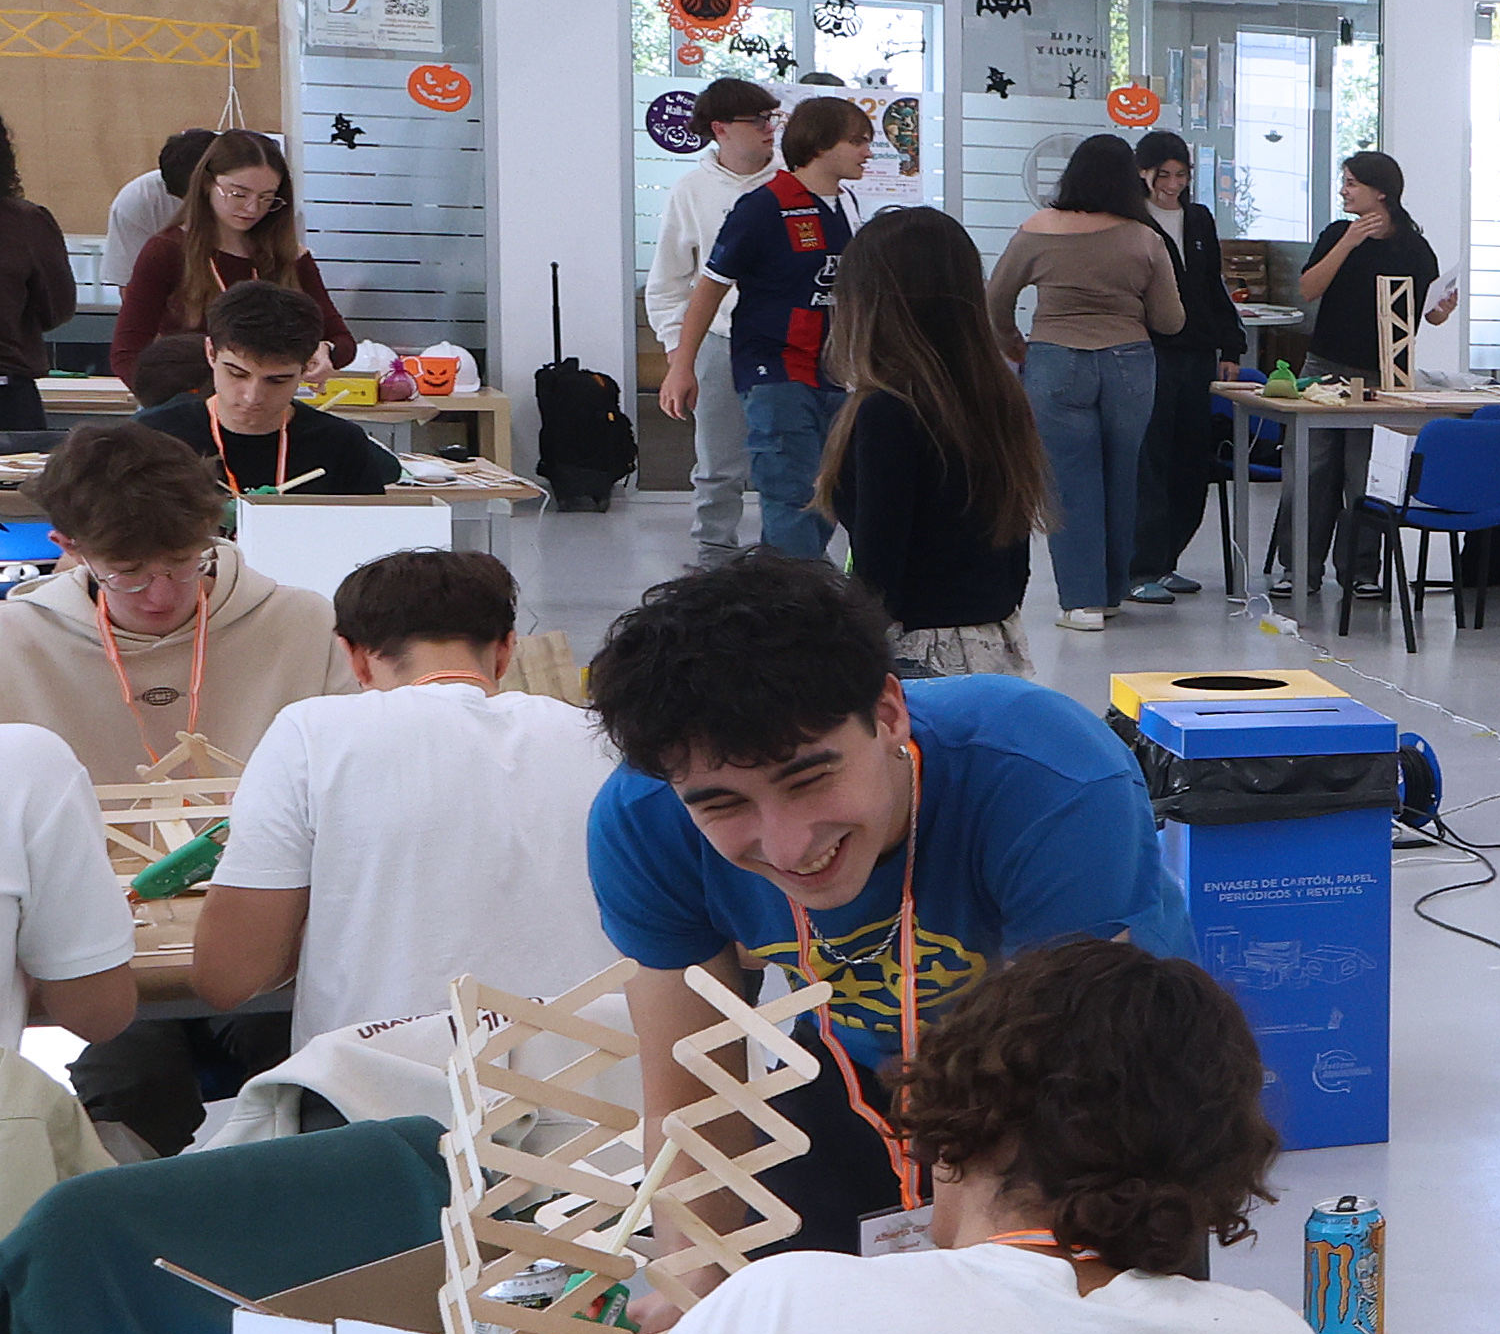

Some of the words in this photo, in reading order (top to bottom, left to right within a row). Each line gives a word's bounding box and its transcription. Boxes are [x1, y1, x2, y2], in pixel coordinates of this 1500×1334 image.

[1204, 880, 1259, 893] ENVASES
[1261, 878, 1279, 889] DE
[1281, 874, 1334, 888] CARTÓN,
[1336, 873, 1378, 885] PAPEL,
[1218, 889, 1291, 903] PERIÓDICOS
[1295, 889, 1302, 898] Y
[1306, 885, 1363, 897] REVISTAS
